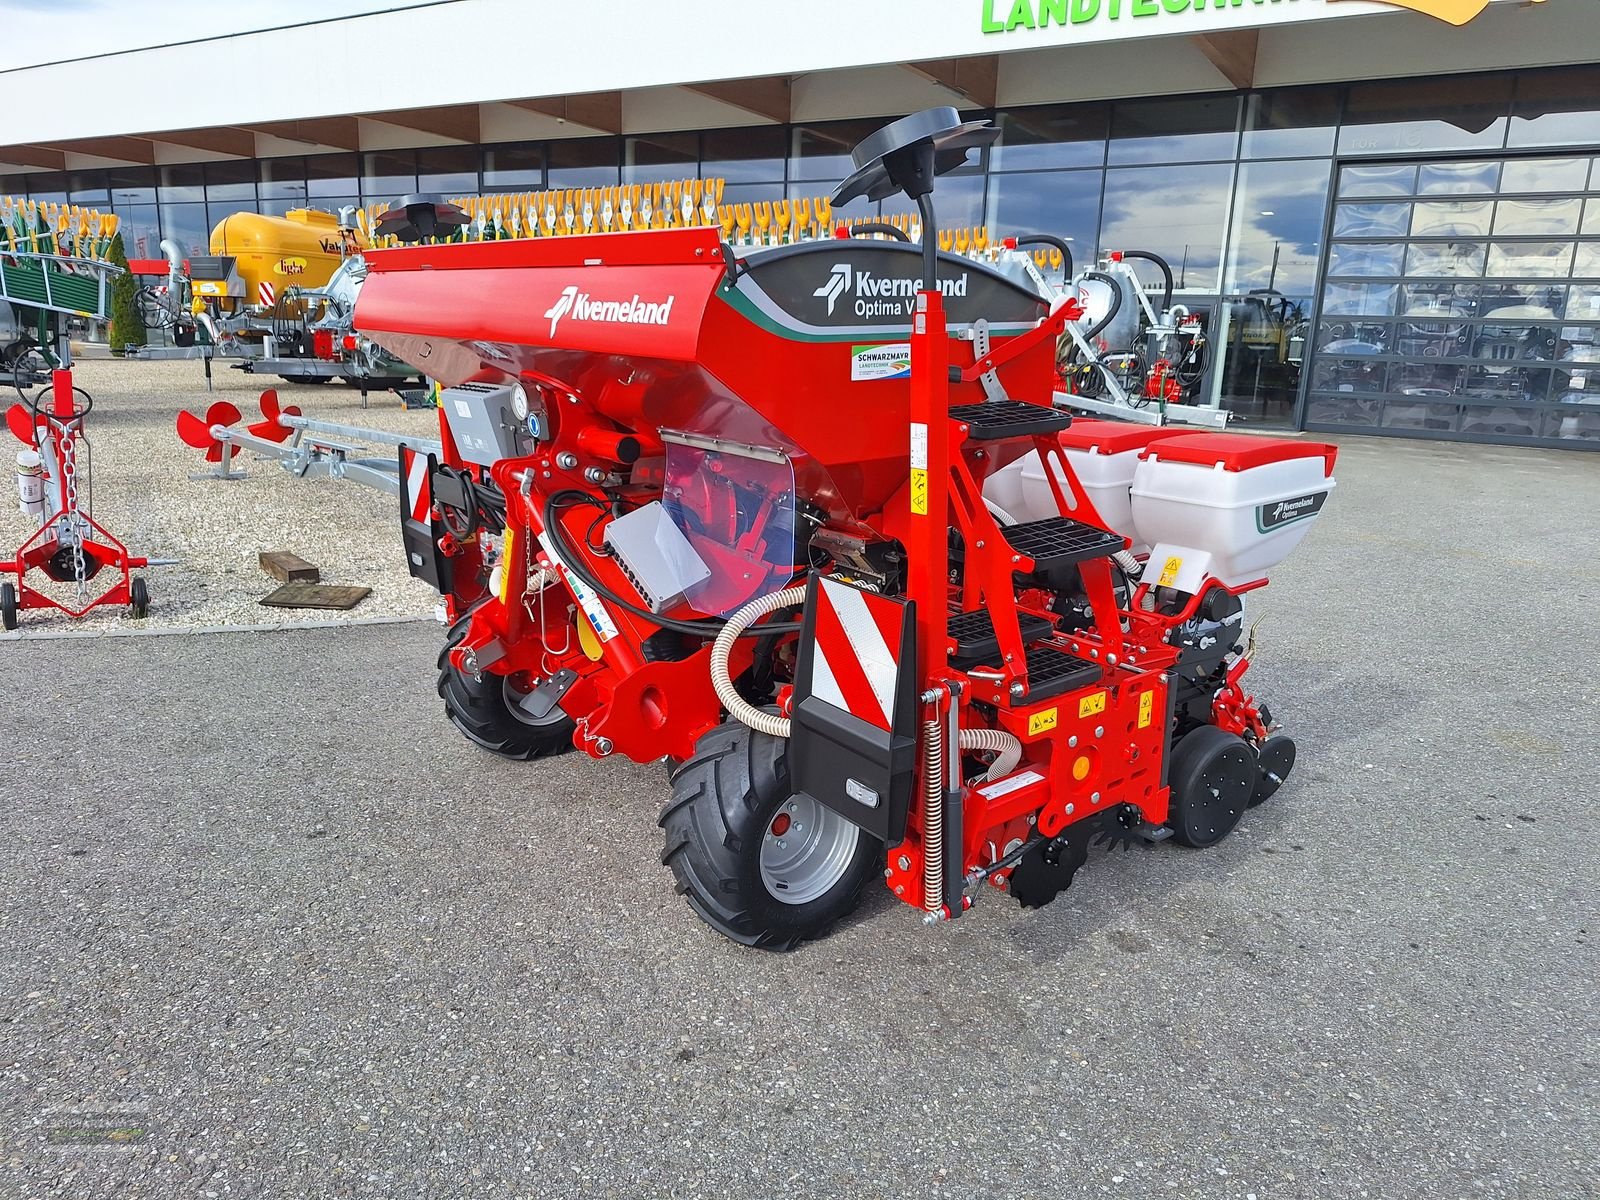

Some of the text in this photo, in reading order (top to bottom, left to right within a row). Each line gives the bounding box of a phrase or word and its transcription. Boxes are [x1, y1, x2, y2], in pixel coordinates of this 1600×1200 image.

[280, 259, 304, 275] light
[856, 271, 967, 296] Kvernend
[571, 293, 674, 325] Kverneland
[855, 299, 901, 319] Optima
[858, 352, 909, 362] SCHWARZMAYR
[1283, 496, 1313, 511] Kverneland
[1281, 510, 1298, 519] Optima
